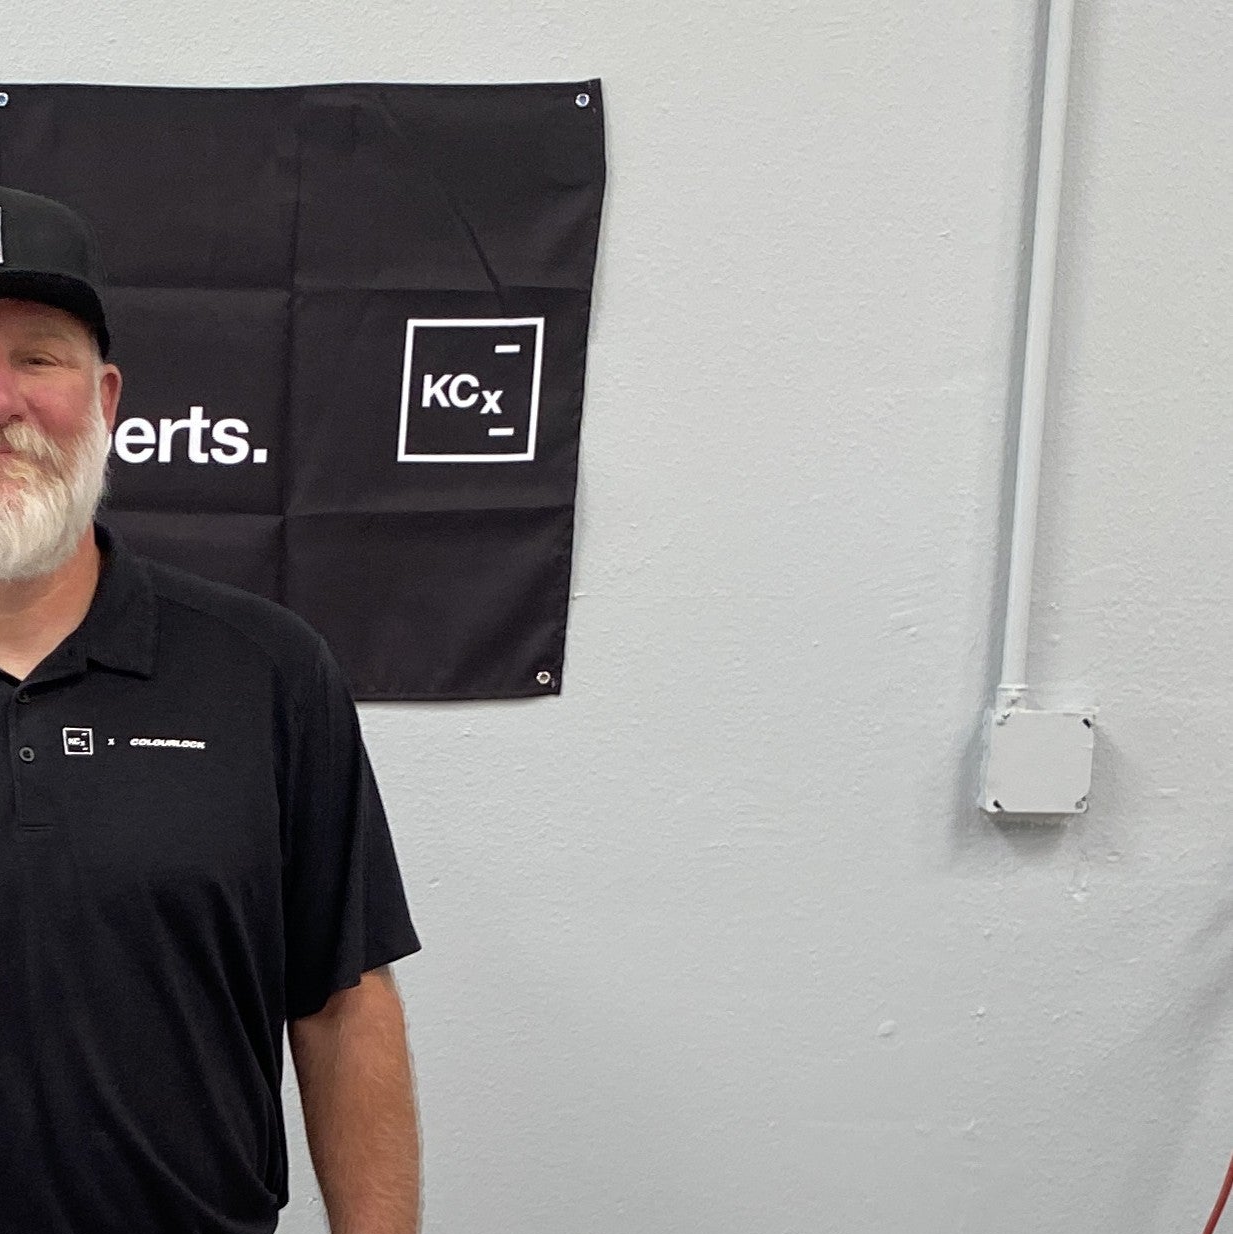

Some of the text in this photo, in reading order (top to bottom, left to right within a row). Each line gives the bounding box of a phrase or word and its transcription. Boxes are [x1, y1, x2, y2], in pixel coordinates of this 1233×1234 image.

[421, 373, 503, 414] KCx
[107, 413, 266, 464] erts.
[129, 738, 206, 750] COLOURLOCK
